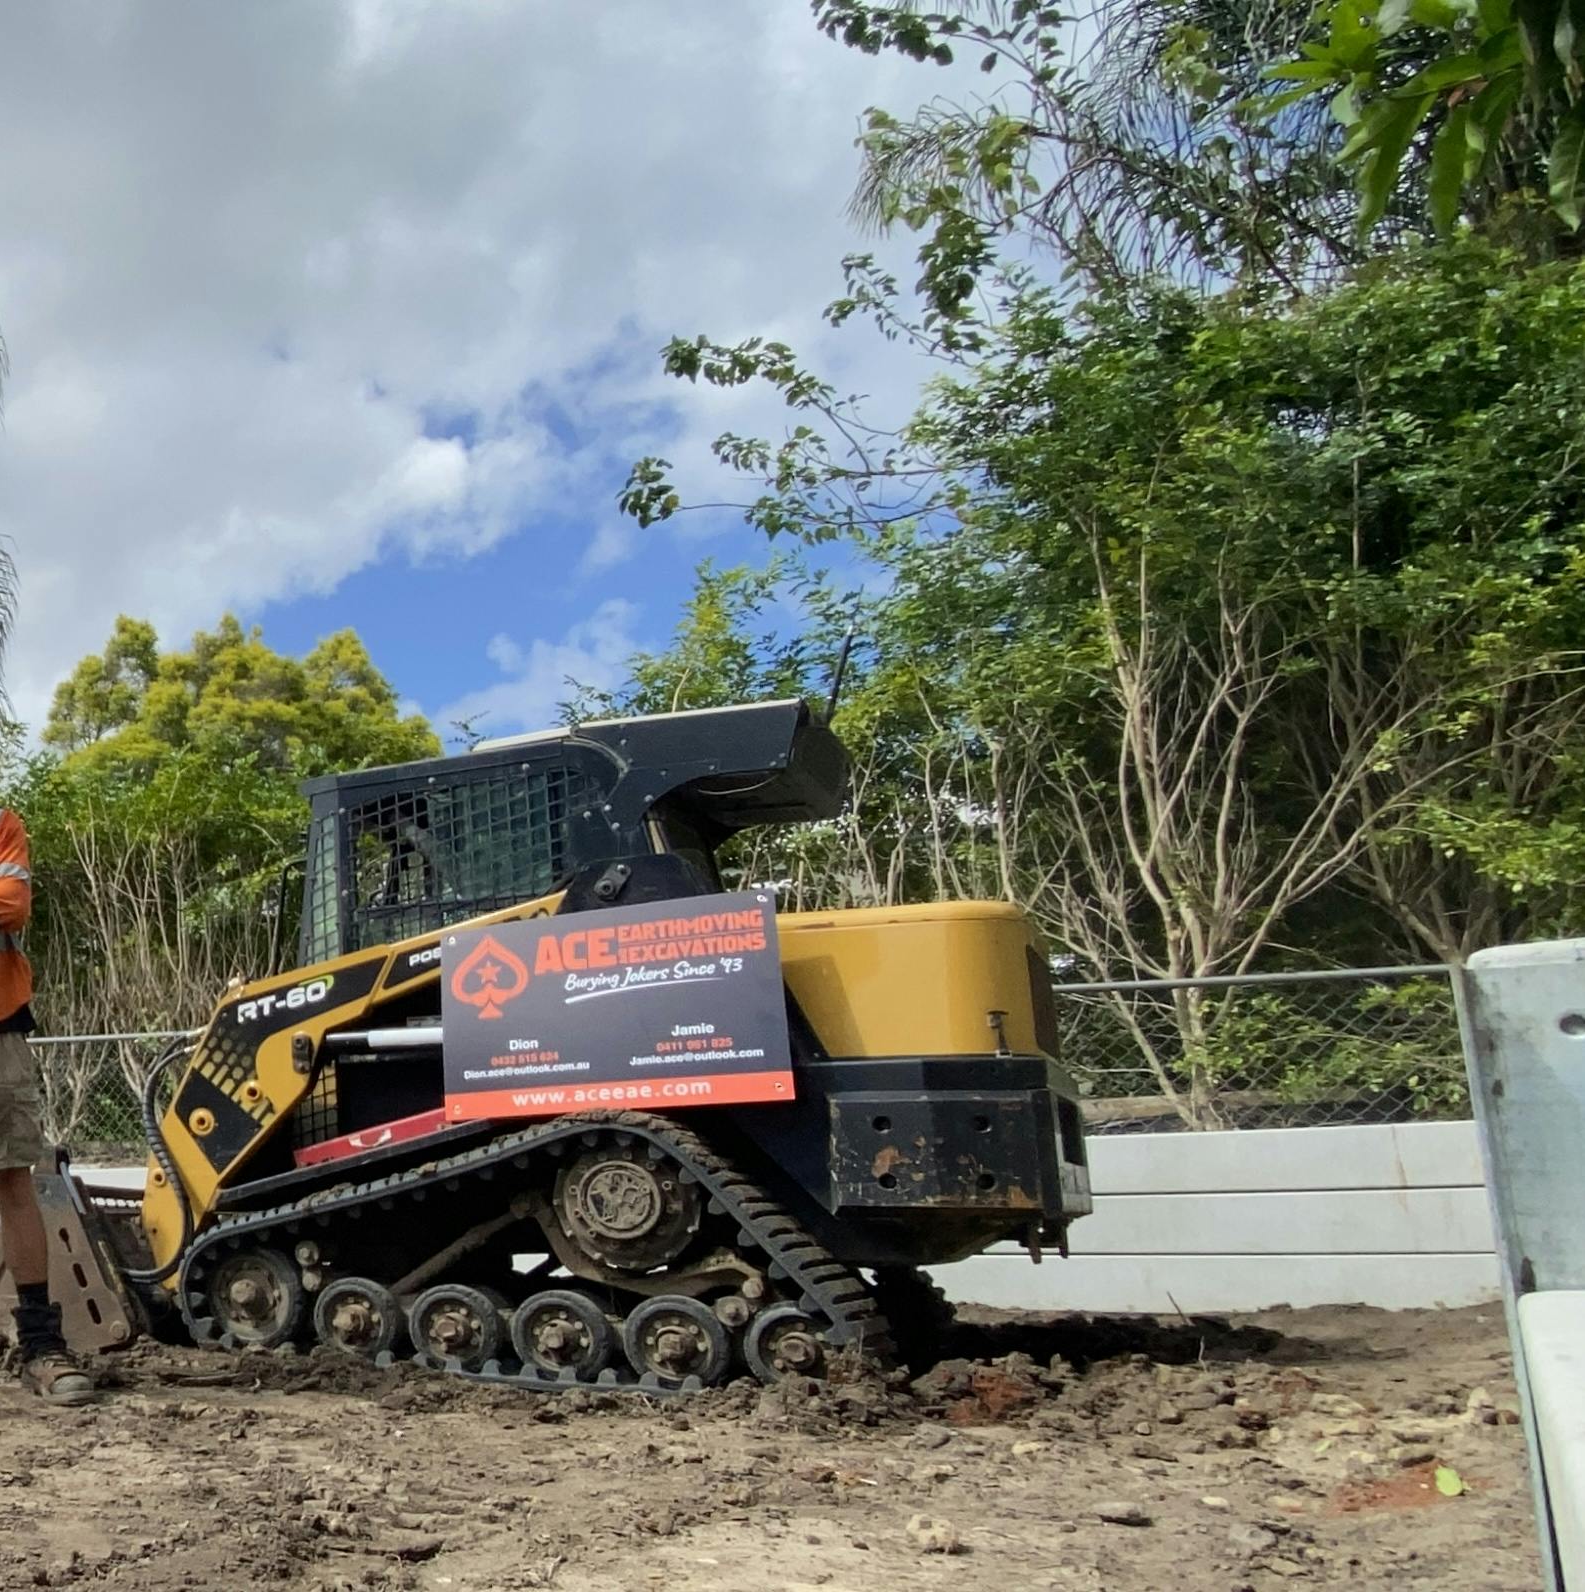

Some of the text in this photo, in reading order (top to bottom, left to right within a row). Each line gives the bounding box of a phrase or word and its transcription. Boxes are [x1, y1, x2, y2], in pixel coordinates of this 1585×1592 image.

[618, 908, 763, 941] EARTHMOVING
[534, 926, 617, 976] ACE
[627, 932, 767, 963] EXCAVATIONS
[564, 970, 621, 991] Burying
[619, 966, 670, 987] Jokers
[673, 960, 716, 980] Since
[237, 980, 327, 1025] RT-60
[509, 1038, 539, 1052] Dion
[671, 1022, 715, 1037] Jamie
[629, 1048, 765, 1067] Jamie.ace@outlook.com
[512, 1080, 712, 1107] www.aceeae.com
